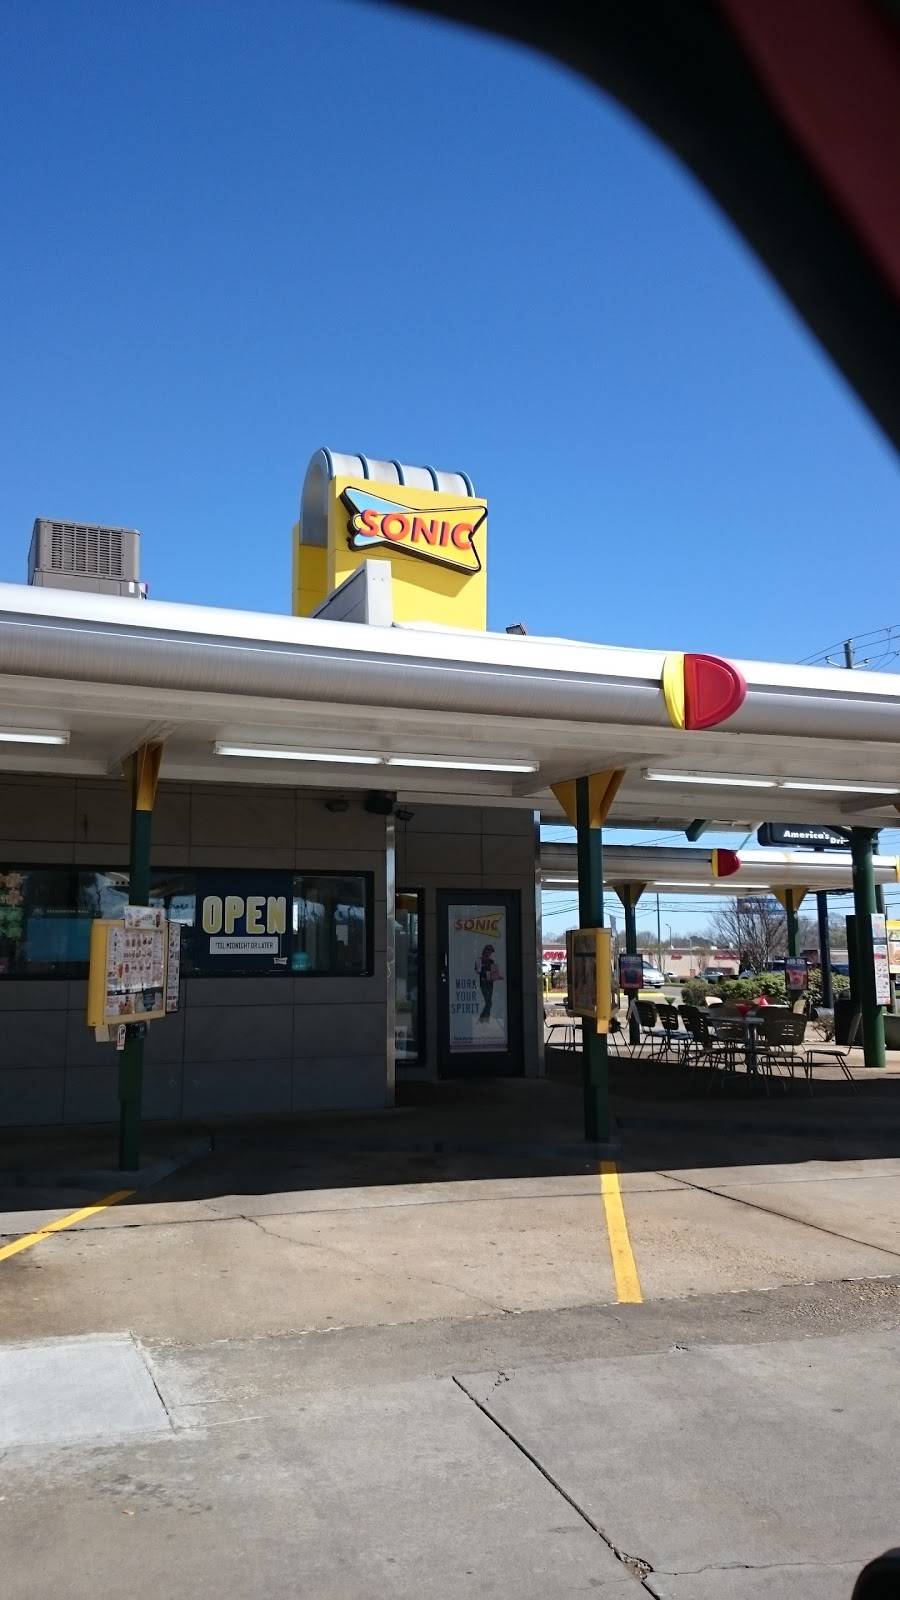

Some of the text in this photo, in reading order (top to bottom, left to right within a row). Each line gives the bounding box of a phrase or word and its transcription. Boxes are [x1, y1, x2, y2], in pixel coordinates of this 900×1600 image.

[358, 509, 474, 550] SONIC
[783, 830, 830, 840] America's
[202, 896, 286, 934] OPEN
[454, 918, 498, 931] SONIC
[456, 979, 478, 990] WORK
[456, 991, 477, 1001] YOUR
[451, 1003, 479, 1014] SPIRIT
